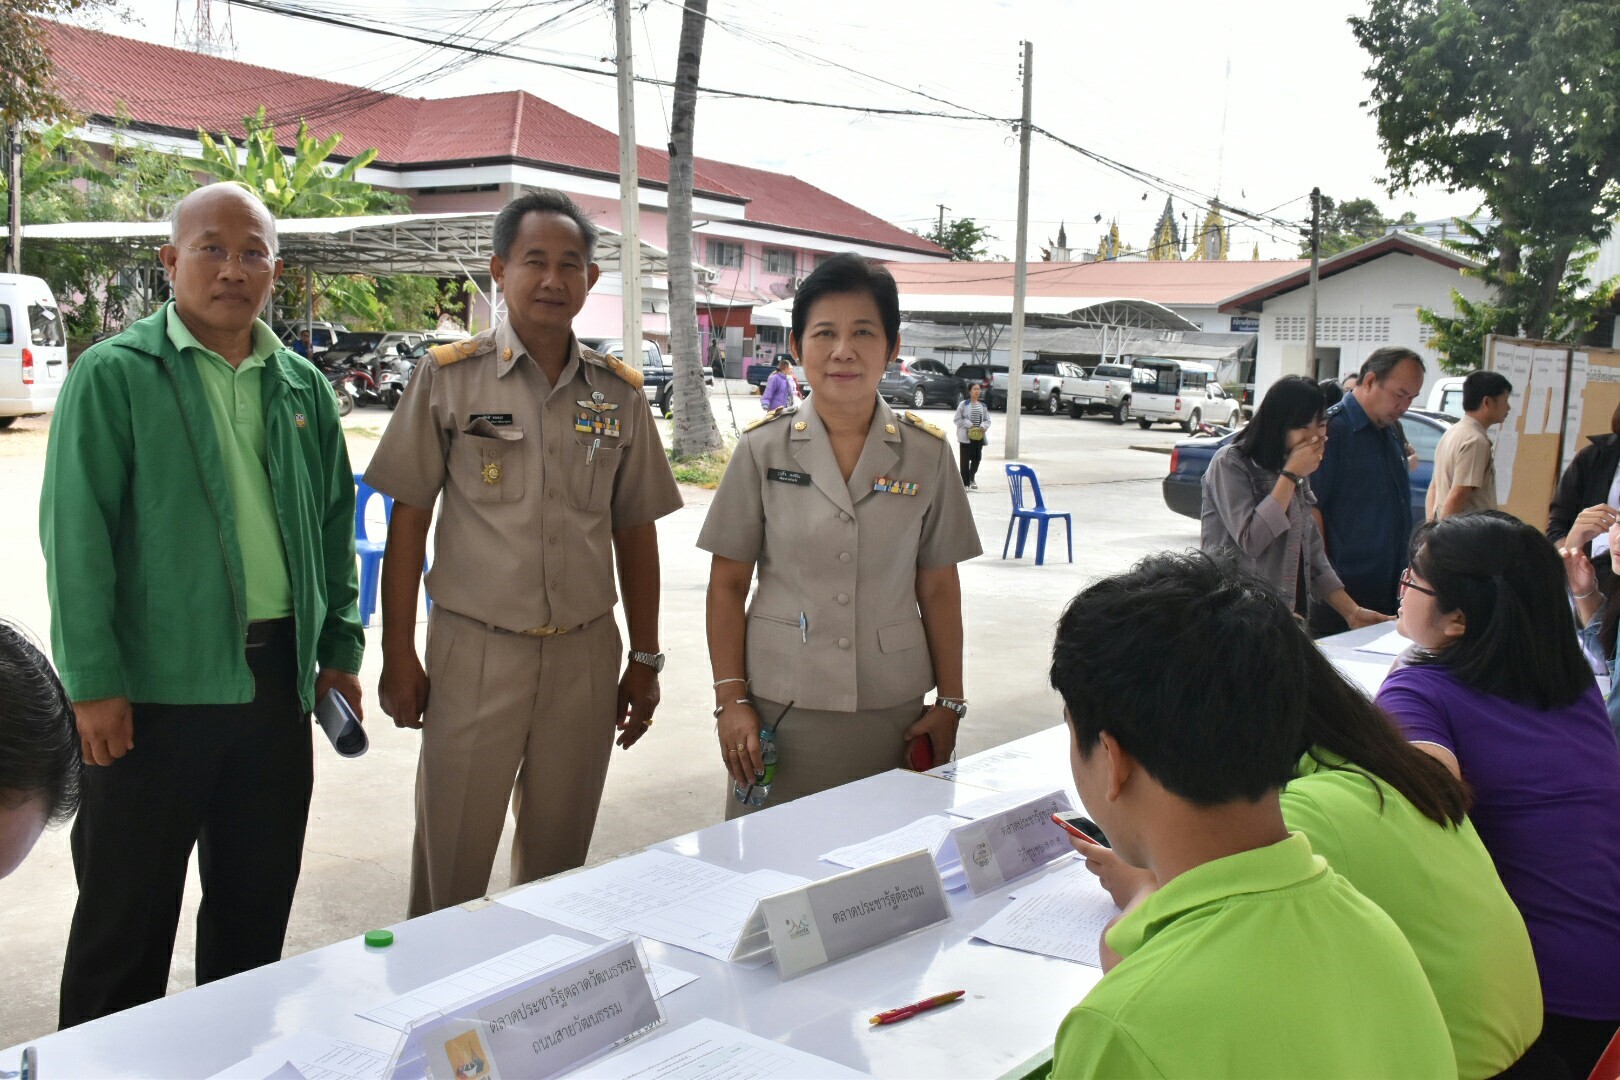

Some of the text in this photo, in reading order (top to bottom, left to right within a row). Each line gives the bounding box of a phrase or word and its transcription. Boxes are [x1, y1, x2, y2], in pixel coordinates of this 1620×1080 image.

[832, 884, 925, 924] ตลาดประชารัฐต้องชม
[489, 956, 637, 1034] ตลาดประชารัฐตลาดวัฒนธรรม
[532, 1001, 623, 1054] ถนนสายวัฒนธรรม
